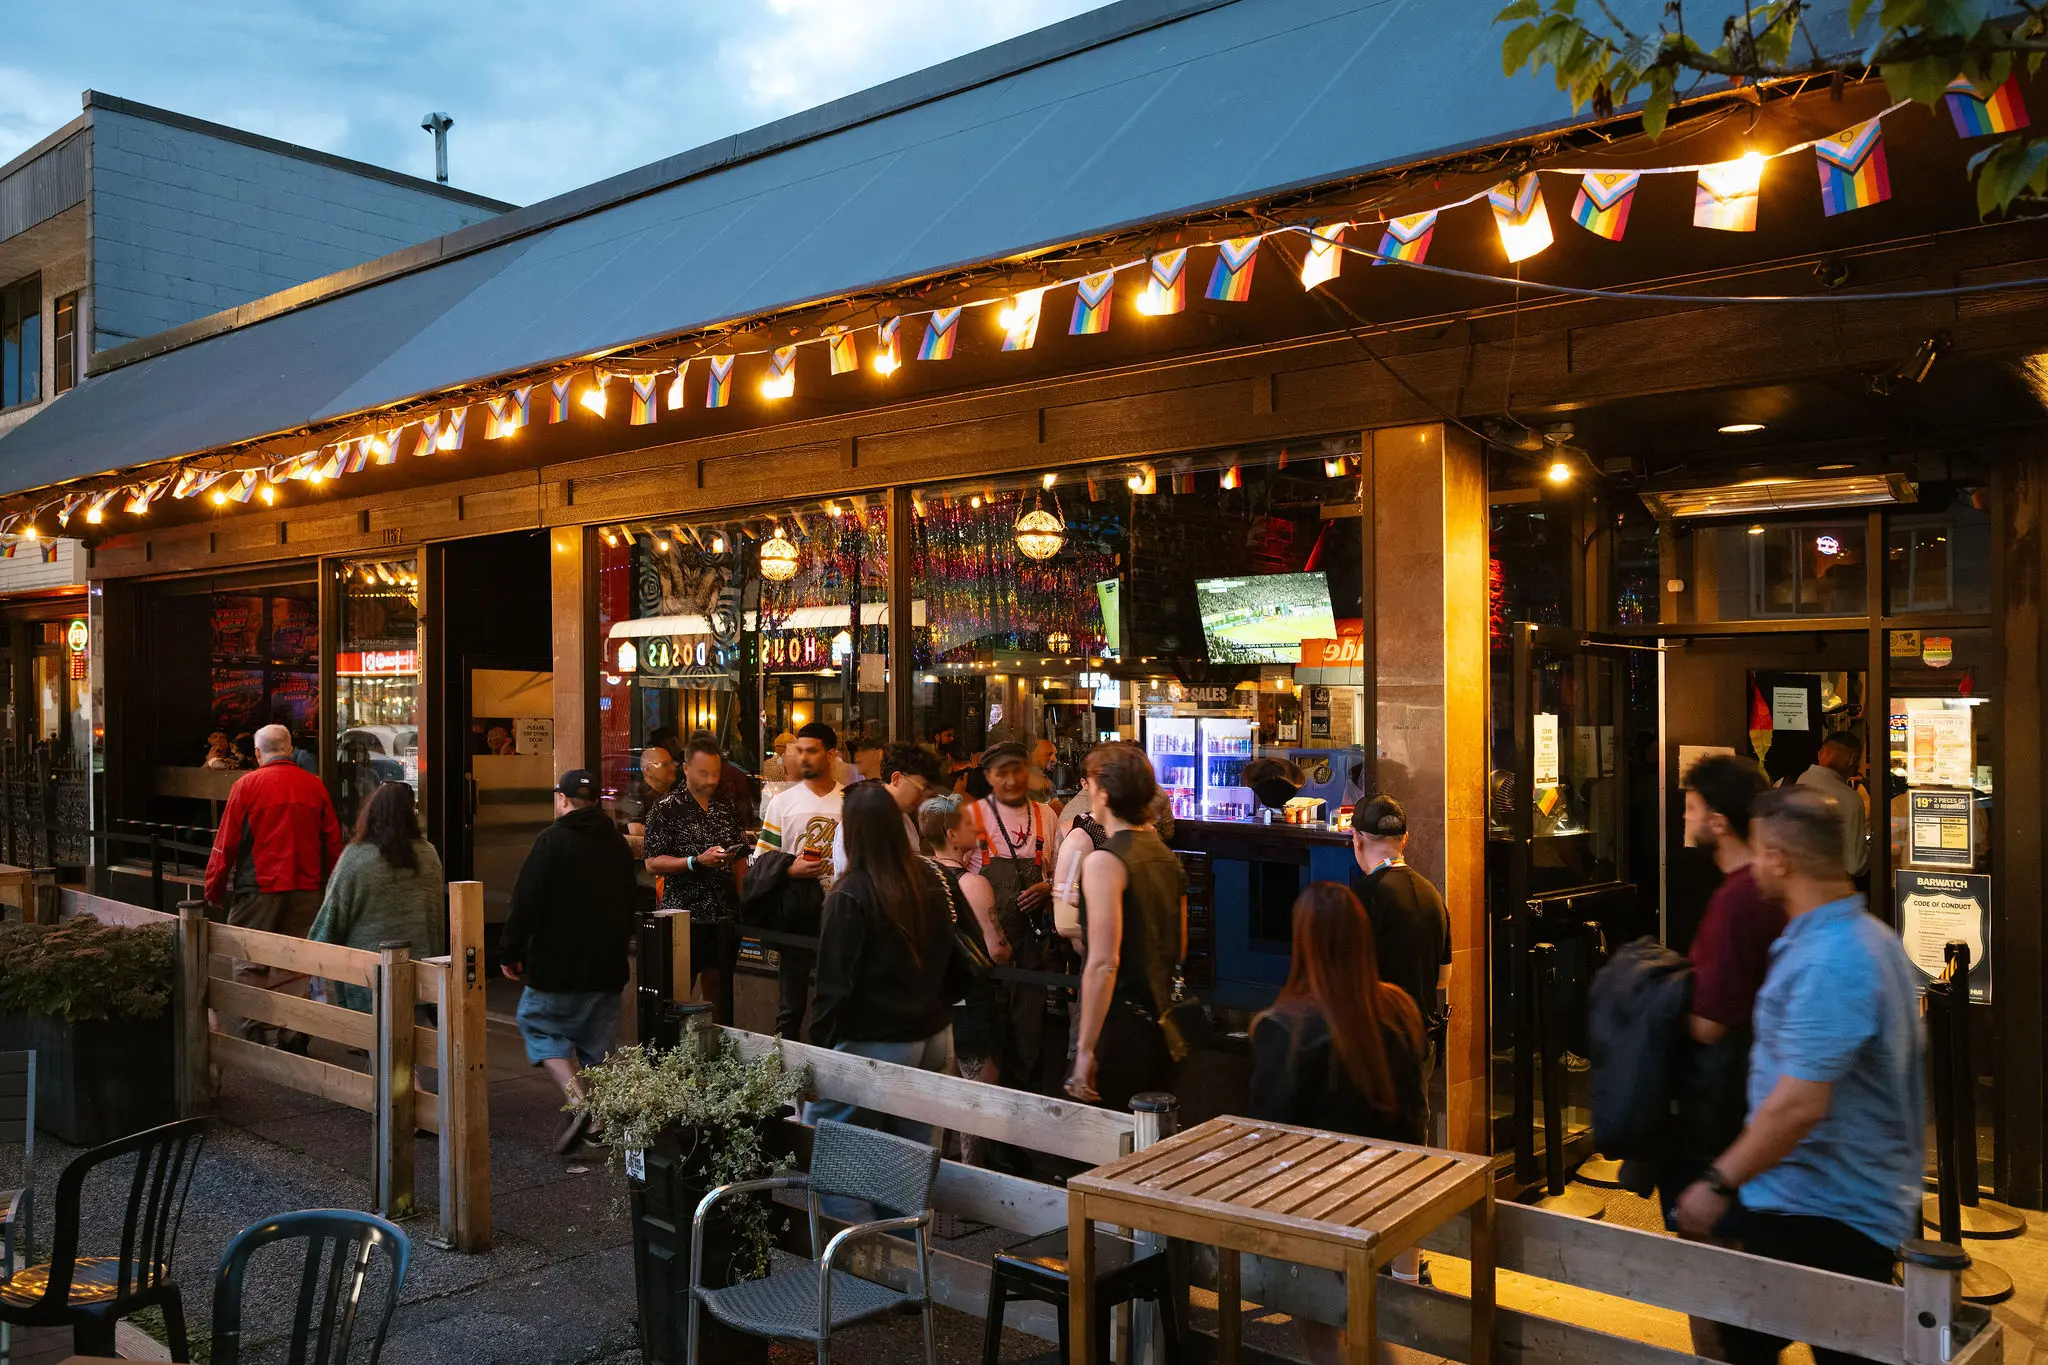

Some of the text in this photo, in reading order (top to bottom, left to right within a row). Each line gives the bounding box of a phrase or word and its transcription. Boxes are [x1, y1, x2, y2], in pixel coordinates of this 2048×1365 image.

[382, 528, 402, 544] 1167
[1190, 687, 1228, 702] SALES
[1916, 797, 1933, 808] 19+
[1916, 877, 1968, 889] BARWATCH
[1913, 900, 1931, 908] CODE
[1941, 902, 1972, 910] CONDUCT
